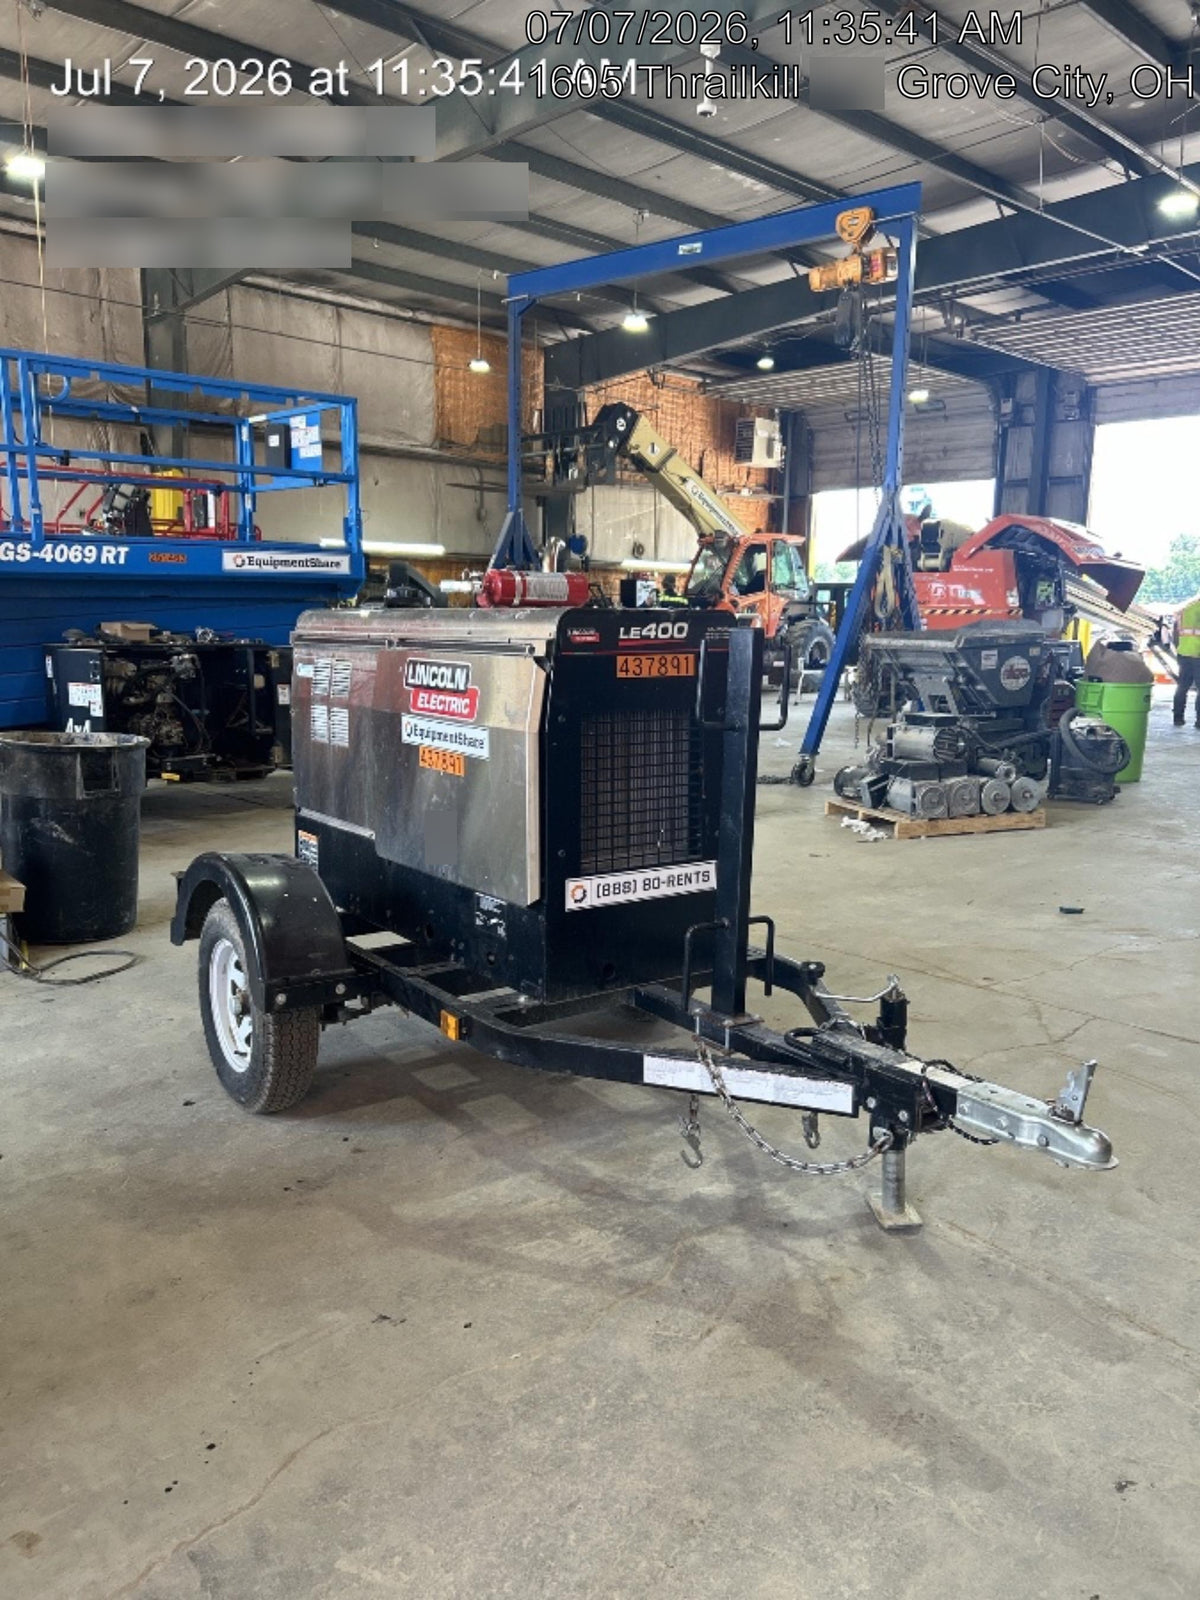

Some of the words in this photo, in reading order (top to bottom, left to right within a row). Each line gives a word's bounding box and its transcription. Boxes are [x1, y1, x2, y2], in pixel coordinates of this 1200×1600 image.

[0, 541, 97, 564] GS-4069
[100, 545, 130, 565] RT
[246, 555, 342, 570] EquipmentShare
[618, 621, 689, 640] LE400
[407, 662, 467, 691] LINCOLN
[618, 656, 691, 677] 437891
[416, 692, 470, 714] ELECTRIC
[413, 723, 486, 750] EquipmentShare
[596, 879, 637, 899] (888)
[642, 870, 711, 892] 80-RENTS
